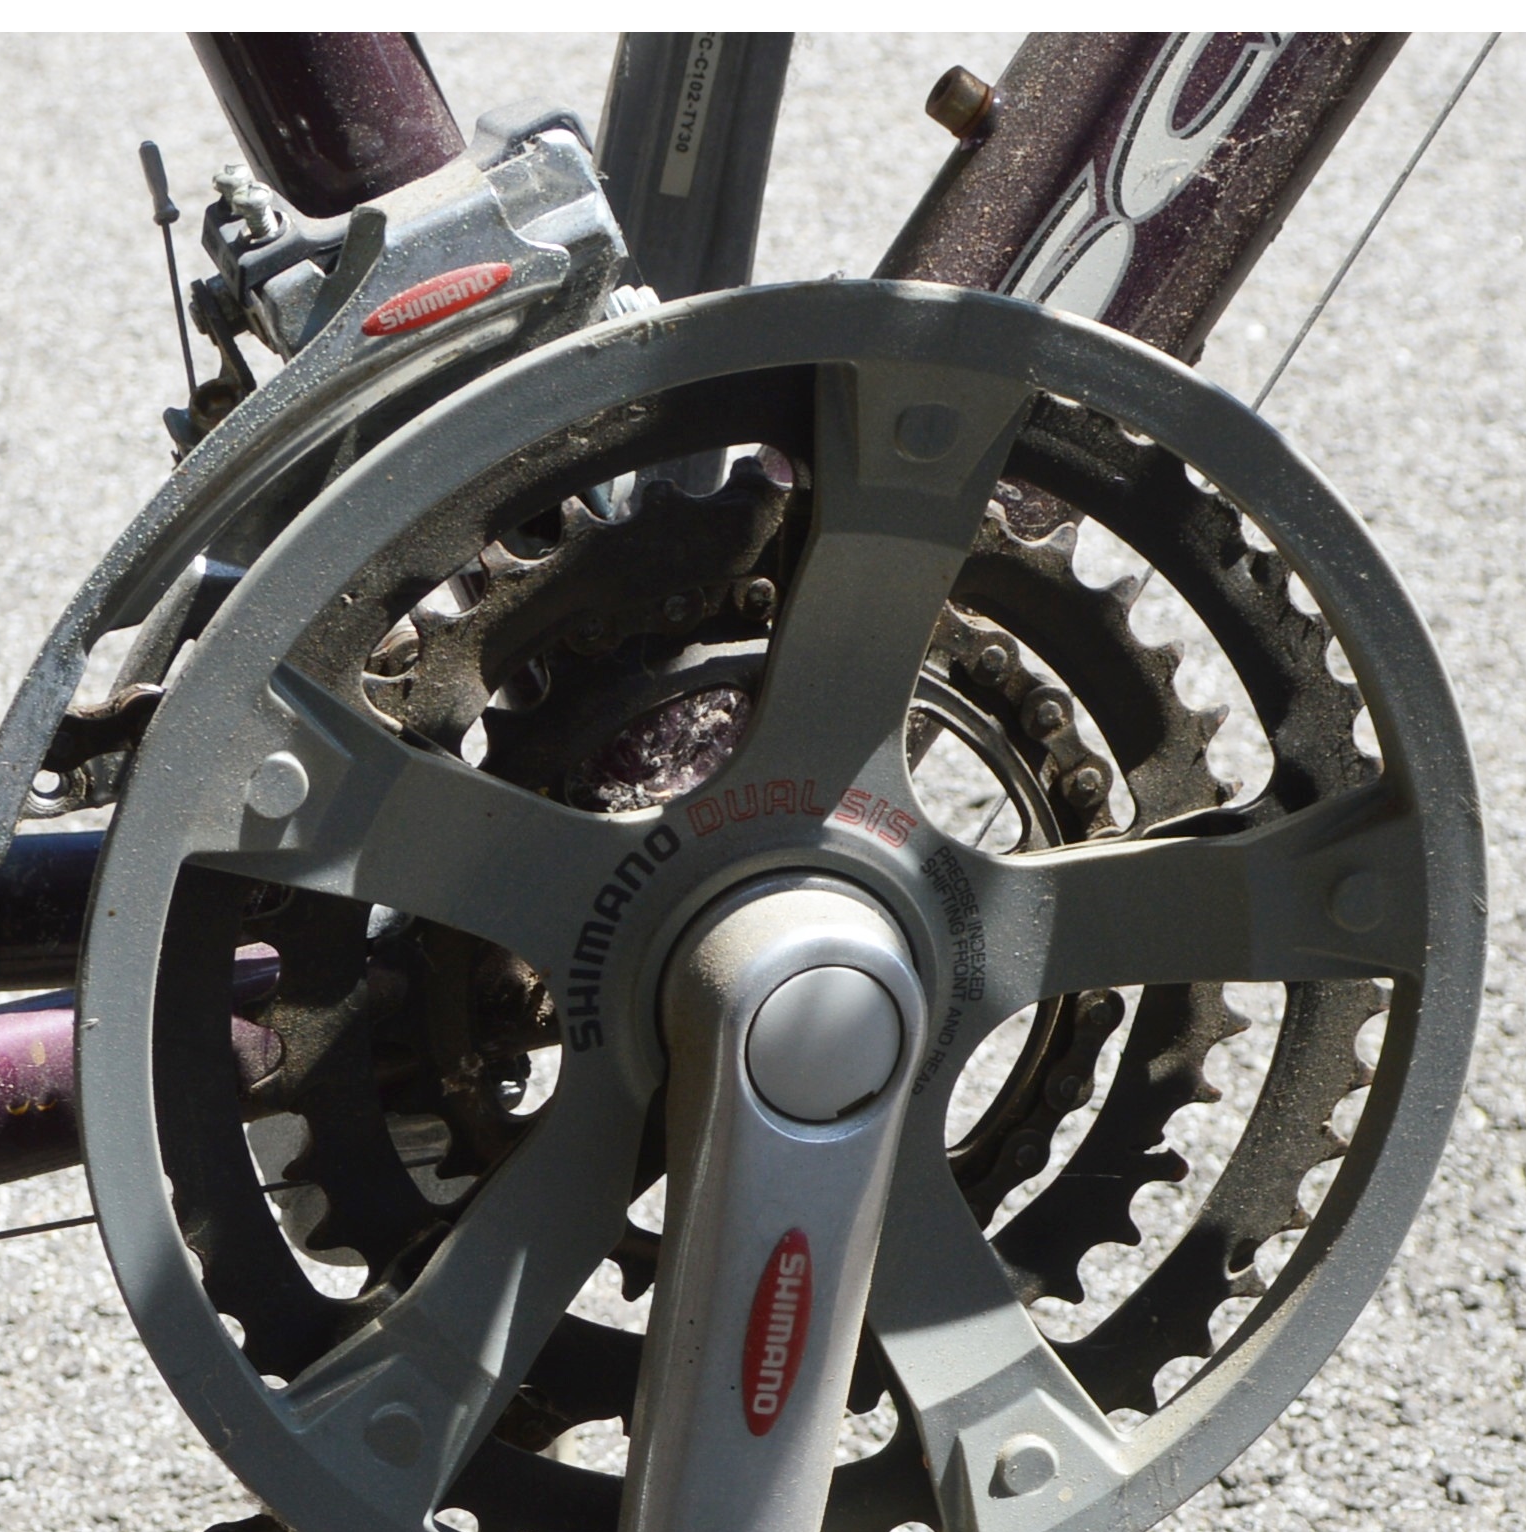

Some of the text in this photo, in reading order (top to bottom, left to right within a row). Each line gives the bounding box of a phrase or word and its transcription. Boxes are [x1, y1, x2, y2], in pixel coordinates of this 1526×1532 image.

[377, 269, 497, 331] SHIMANO
[686, 779, 918, 848] DUAL SIS
[567, 823, 682, 1053] SHIMANO
[911, 857, 970, 1096] SHIFTING FRONT AND REAR
[934, 845, 987, 1002] PRECISE INDEXED
[752, 1252, 807, 1416] SHIMANO
